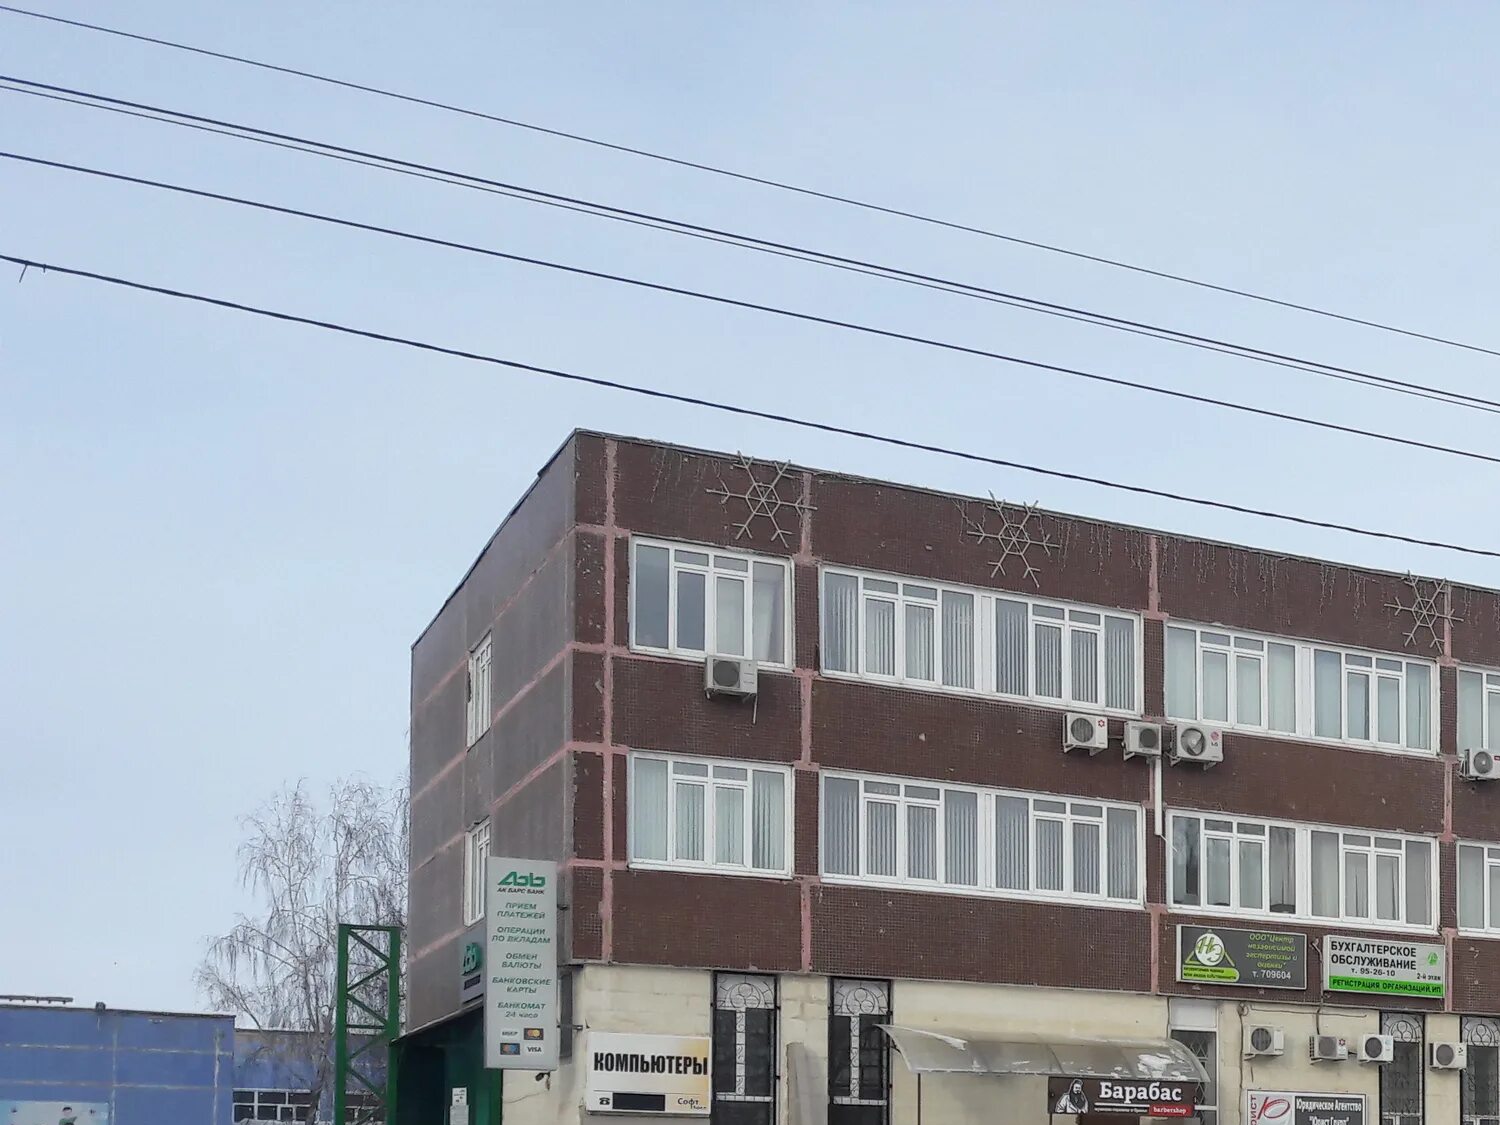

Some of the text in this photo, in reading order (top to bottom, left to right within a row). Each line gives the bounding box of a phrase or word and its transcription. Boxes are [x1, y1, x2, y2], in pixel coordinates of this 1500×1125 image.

[505, 902, 537, 910] ПРИЕМ
[497, 910, 545, 919] ПЛАТЕЖЕЙ
[497, 926, 545, 935] ОПЕРАЦИИ
[507, 935, 551, 944] ВКЛАДАМ
[1247, 943, 1296, 952] независимой
[1331, 940, 1417, 957] БУХГАЛТЕРСКОЕ
[505, 952, 537, 960] ОБМЕН
[1246, 952, 1291, 961] экспертизы
[502, 961, 542, 969] ВАЛЮТЫ
[1331, 953, 1417, 970] ОБСЛУЖИВАНИЕ
[1261, 969, 1292, 979] 709604
[1360, 968, 1396, 977] 95-26-10
[492, 976, 552, 985] БАНКОВСКИЕ
[1332, 979, 1380, 989] РЕГИСТРАЦИЯ
[506, 986, 537, 994] КАРТЫ
[497, 1001, 546, 1010] БАНКОМАТ
[593, 1052, 709, 1075] КОМПЬЮТЕРЫ
[1099, 1081, 1182, 1104] Барабас
[677, 1097, 700, 1110] Софт
[1295, 1098, 1362, 1112] Юридическое Агентство
[1153, 1106, 1187, 1115] barbershop
